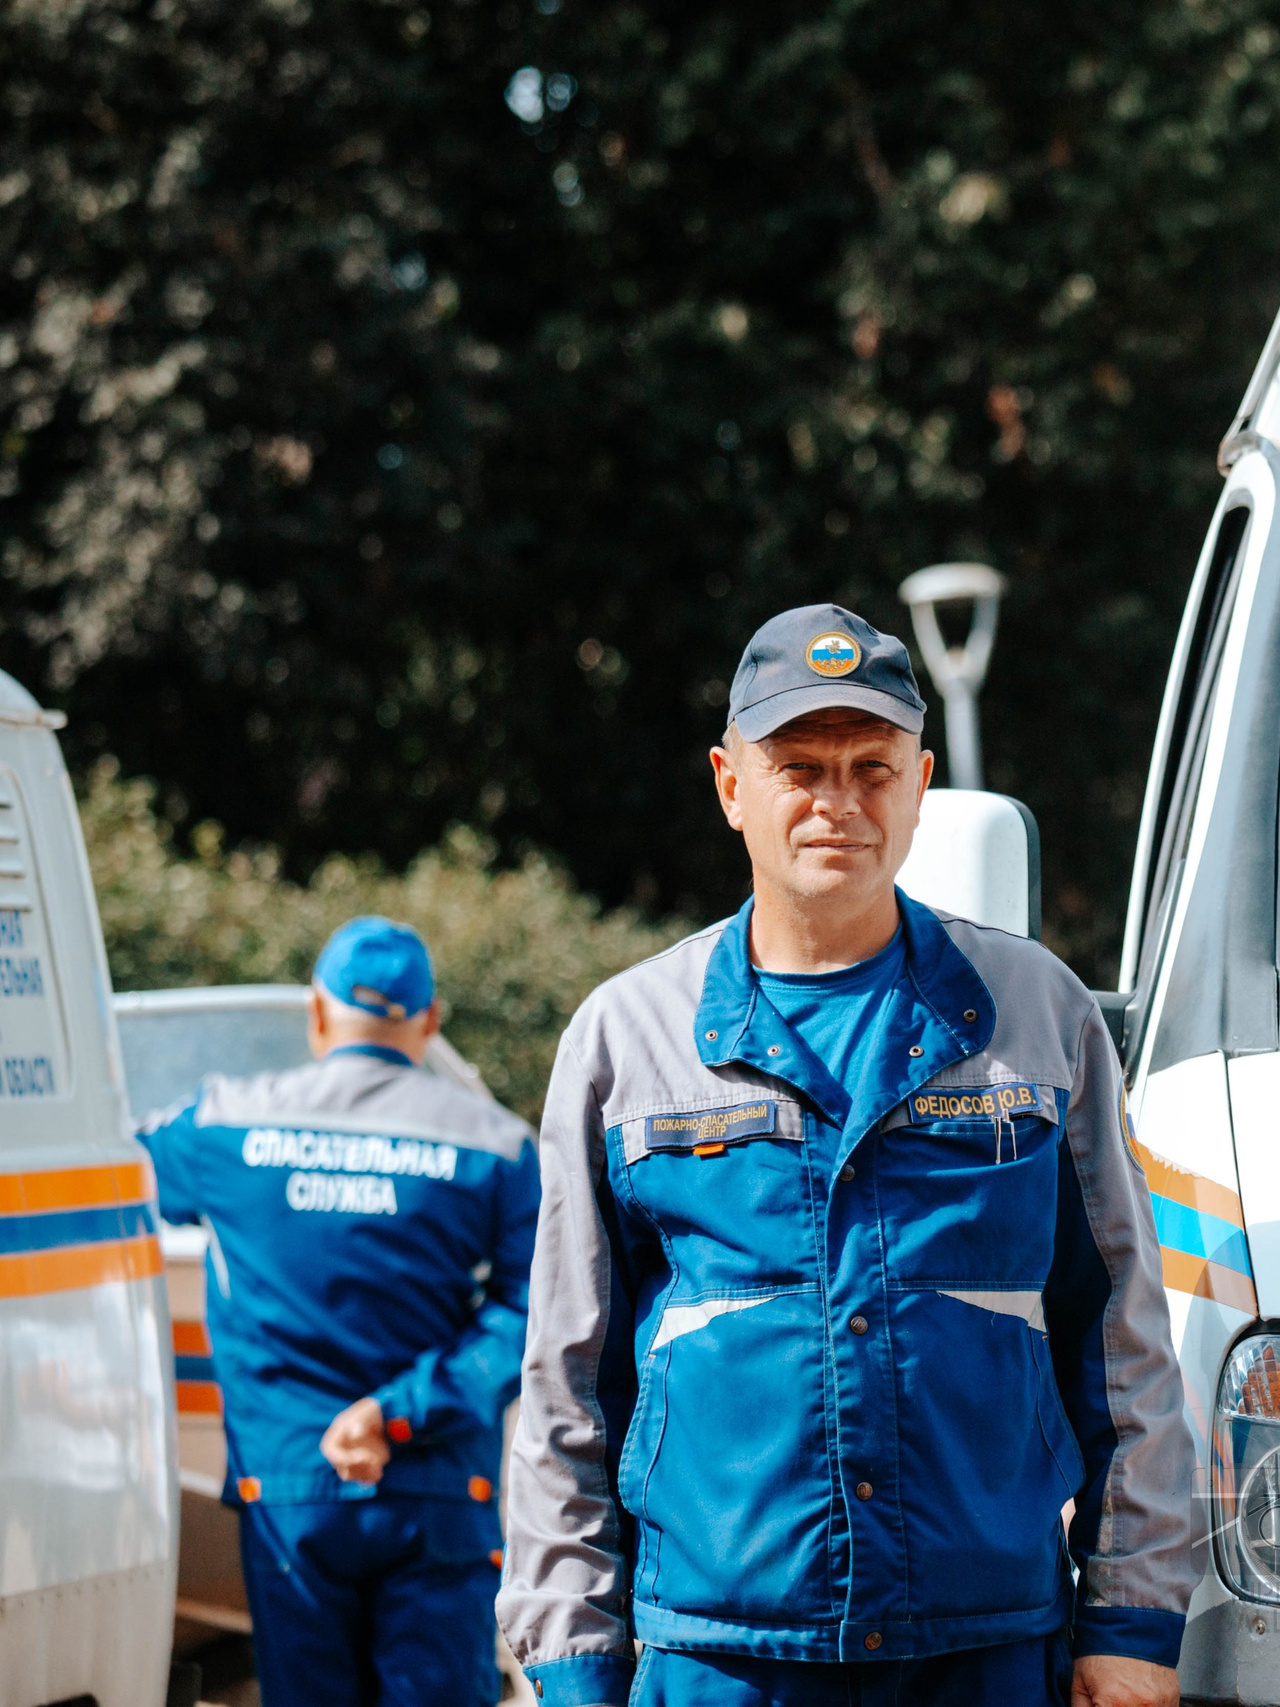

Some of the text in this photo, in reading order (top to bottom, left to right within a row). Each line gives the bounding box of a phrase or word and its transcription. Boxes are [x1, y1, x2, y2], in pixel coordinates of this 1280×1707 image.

[653, 1103, 768, 1132] ПОЖАРНО-СПАСАТЕЛЬНЫЙ
[914, 1086, 1037, 1119] ФЕДОСОВ Ю.В.
[697, 1124, 727, 1140] ЦЕНТР
[241, 1127, 458, 1181] СПАСАТЕЛЬНАЯ
[285, 1170, 398, 1216] СЛУЖБА
